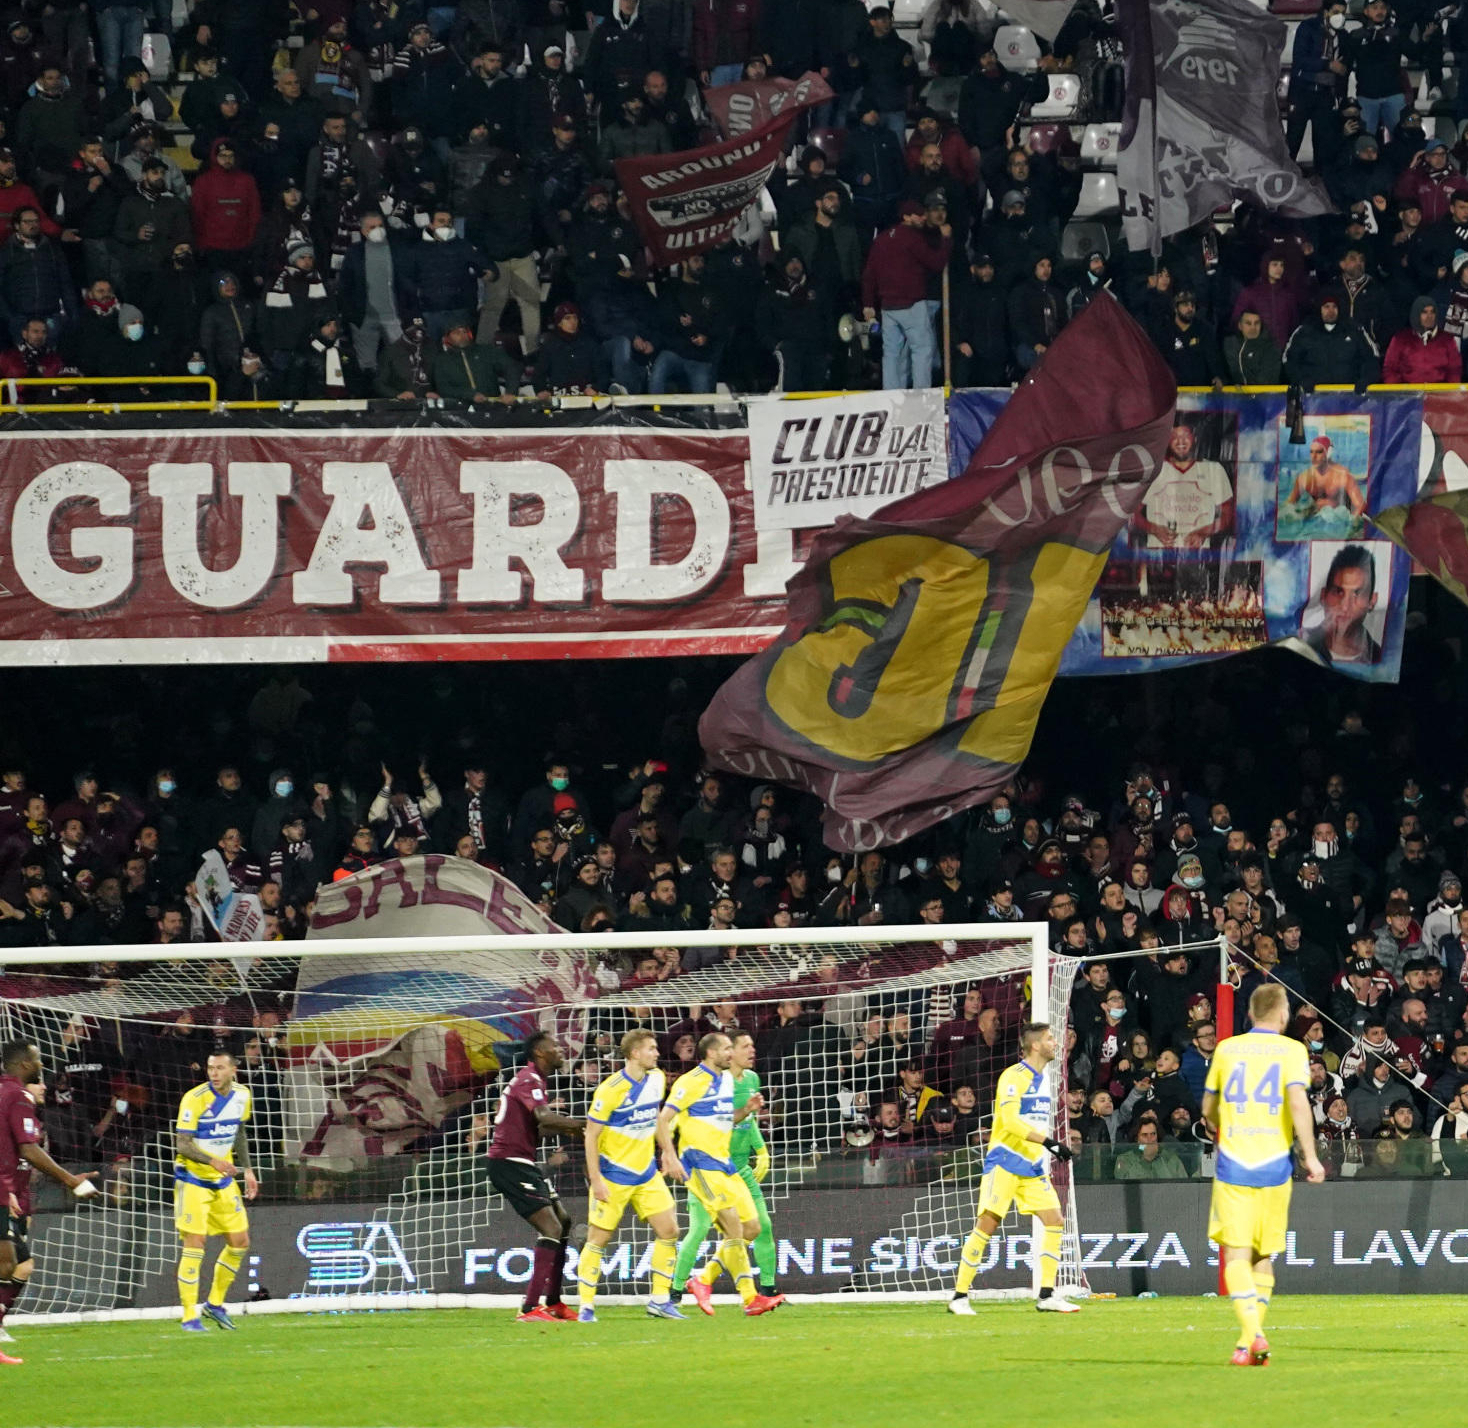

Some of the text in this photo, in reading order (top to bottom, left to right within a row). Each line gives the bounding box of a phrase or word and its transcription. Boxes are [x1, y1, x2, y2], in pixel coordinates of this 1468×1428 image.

[771, 409, 931, 465] CLUB DAL
[767, 457, 932, 506] PRESIDENTE
[1223, 1061, 1285, 1114] 44
[629, 1107, 657, 1122] Jeep
